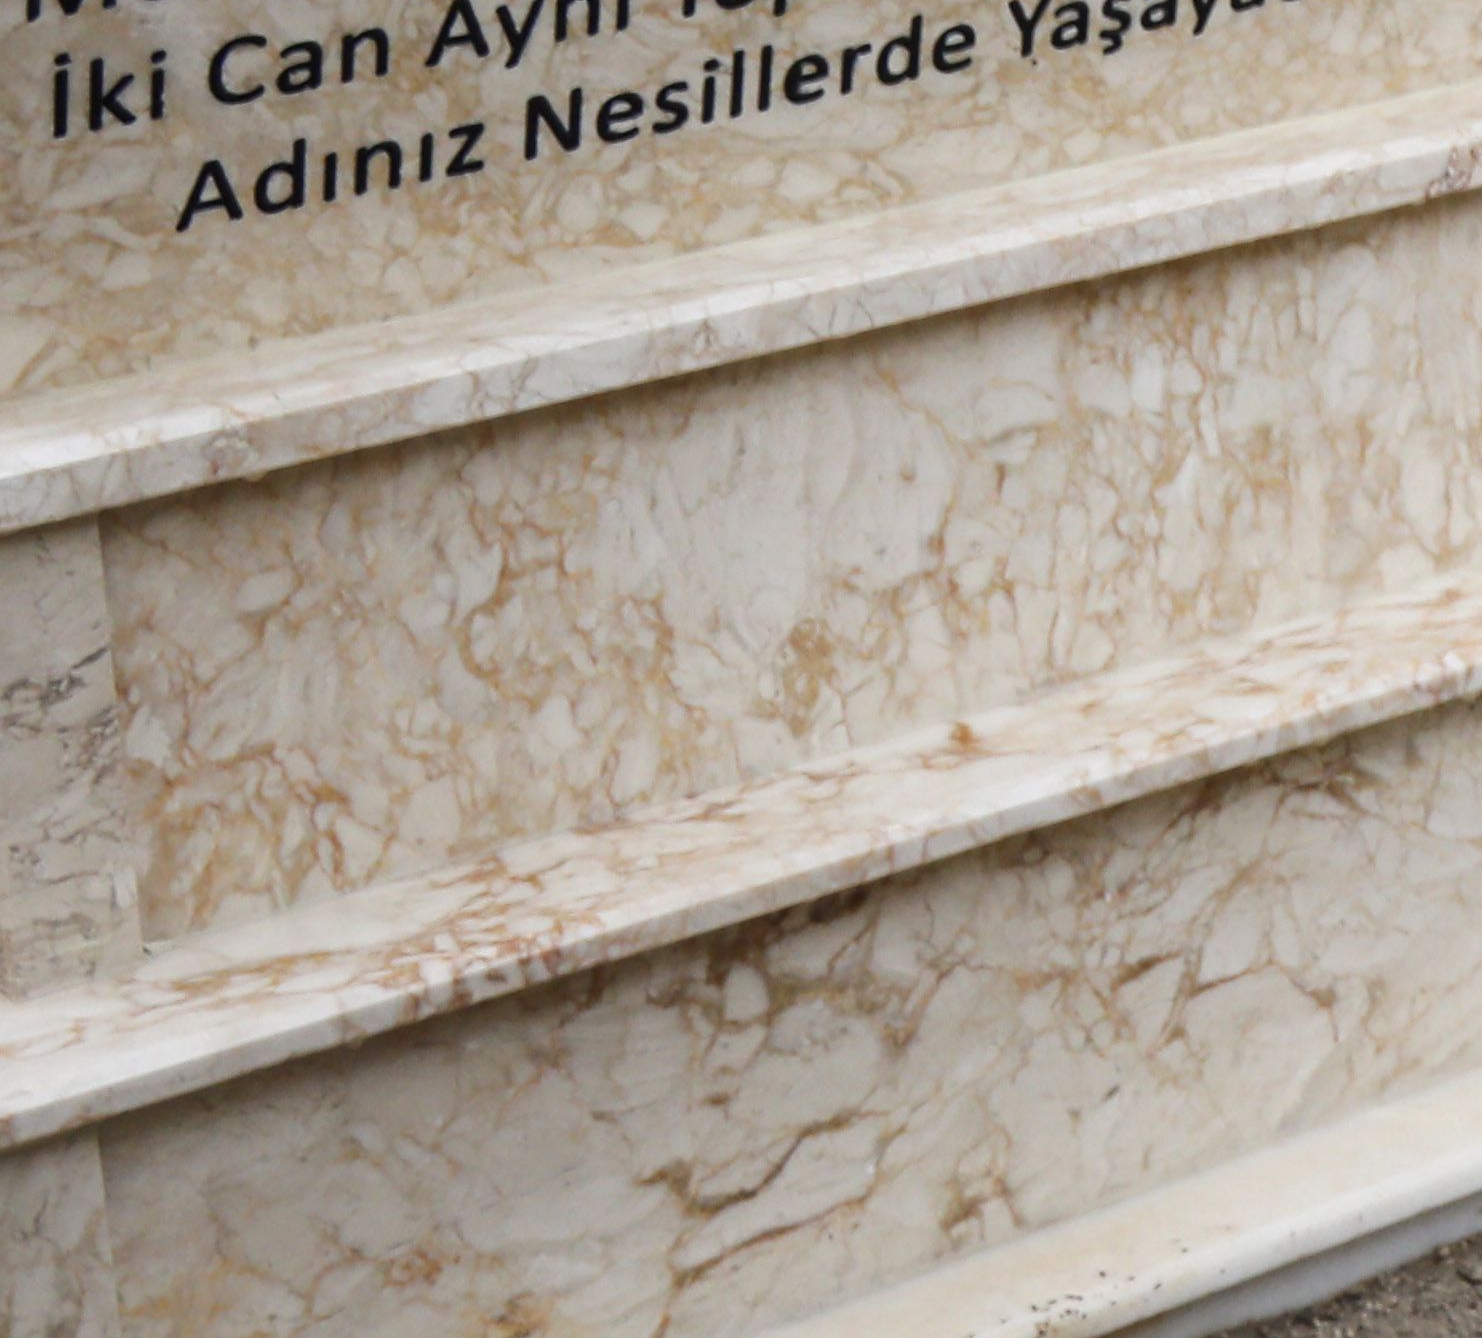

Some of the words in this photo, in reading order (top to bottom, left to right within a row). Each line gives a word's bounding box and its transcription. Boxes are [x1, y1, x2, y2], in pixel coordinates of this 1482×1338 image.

[50, 48, 169, 141] İki
[205, 25, 392, 107] Can
[173, 120, 487, 235] Adınız
[522, 13, 977, 162] Nesillerde
